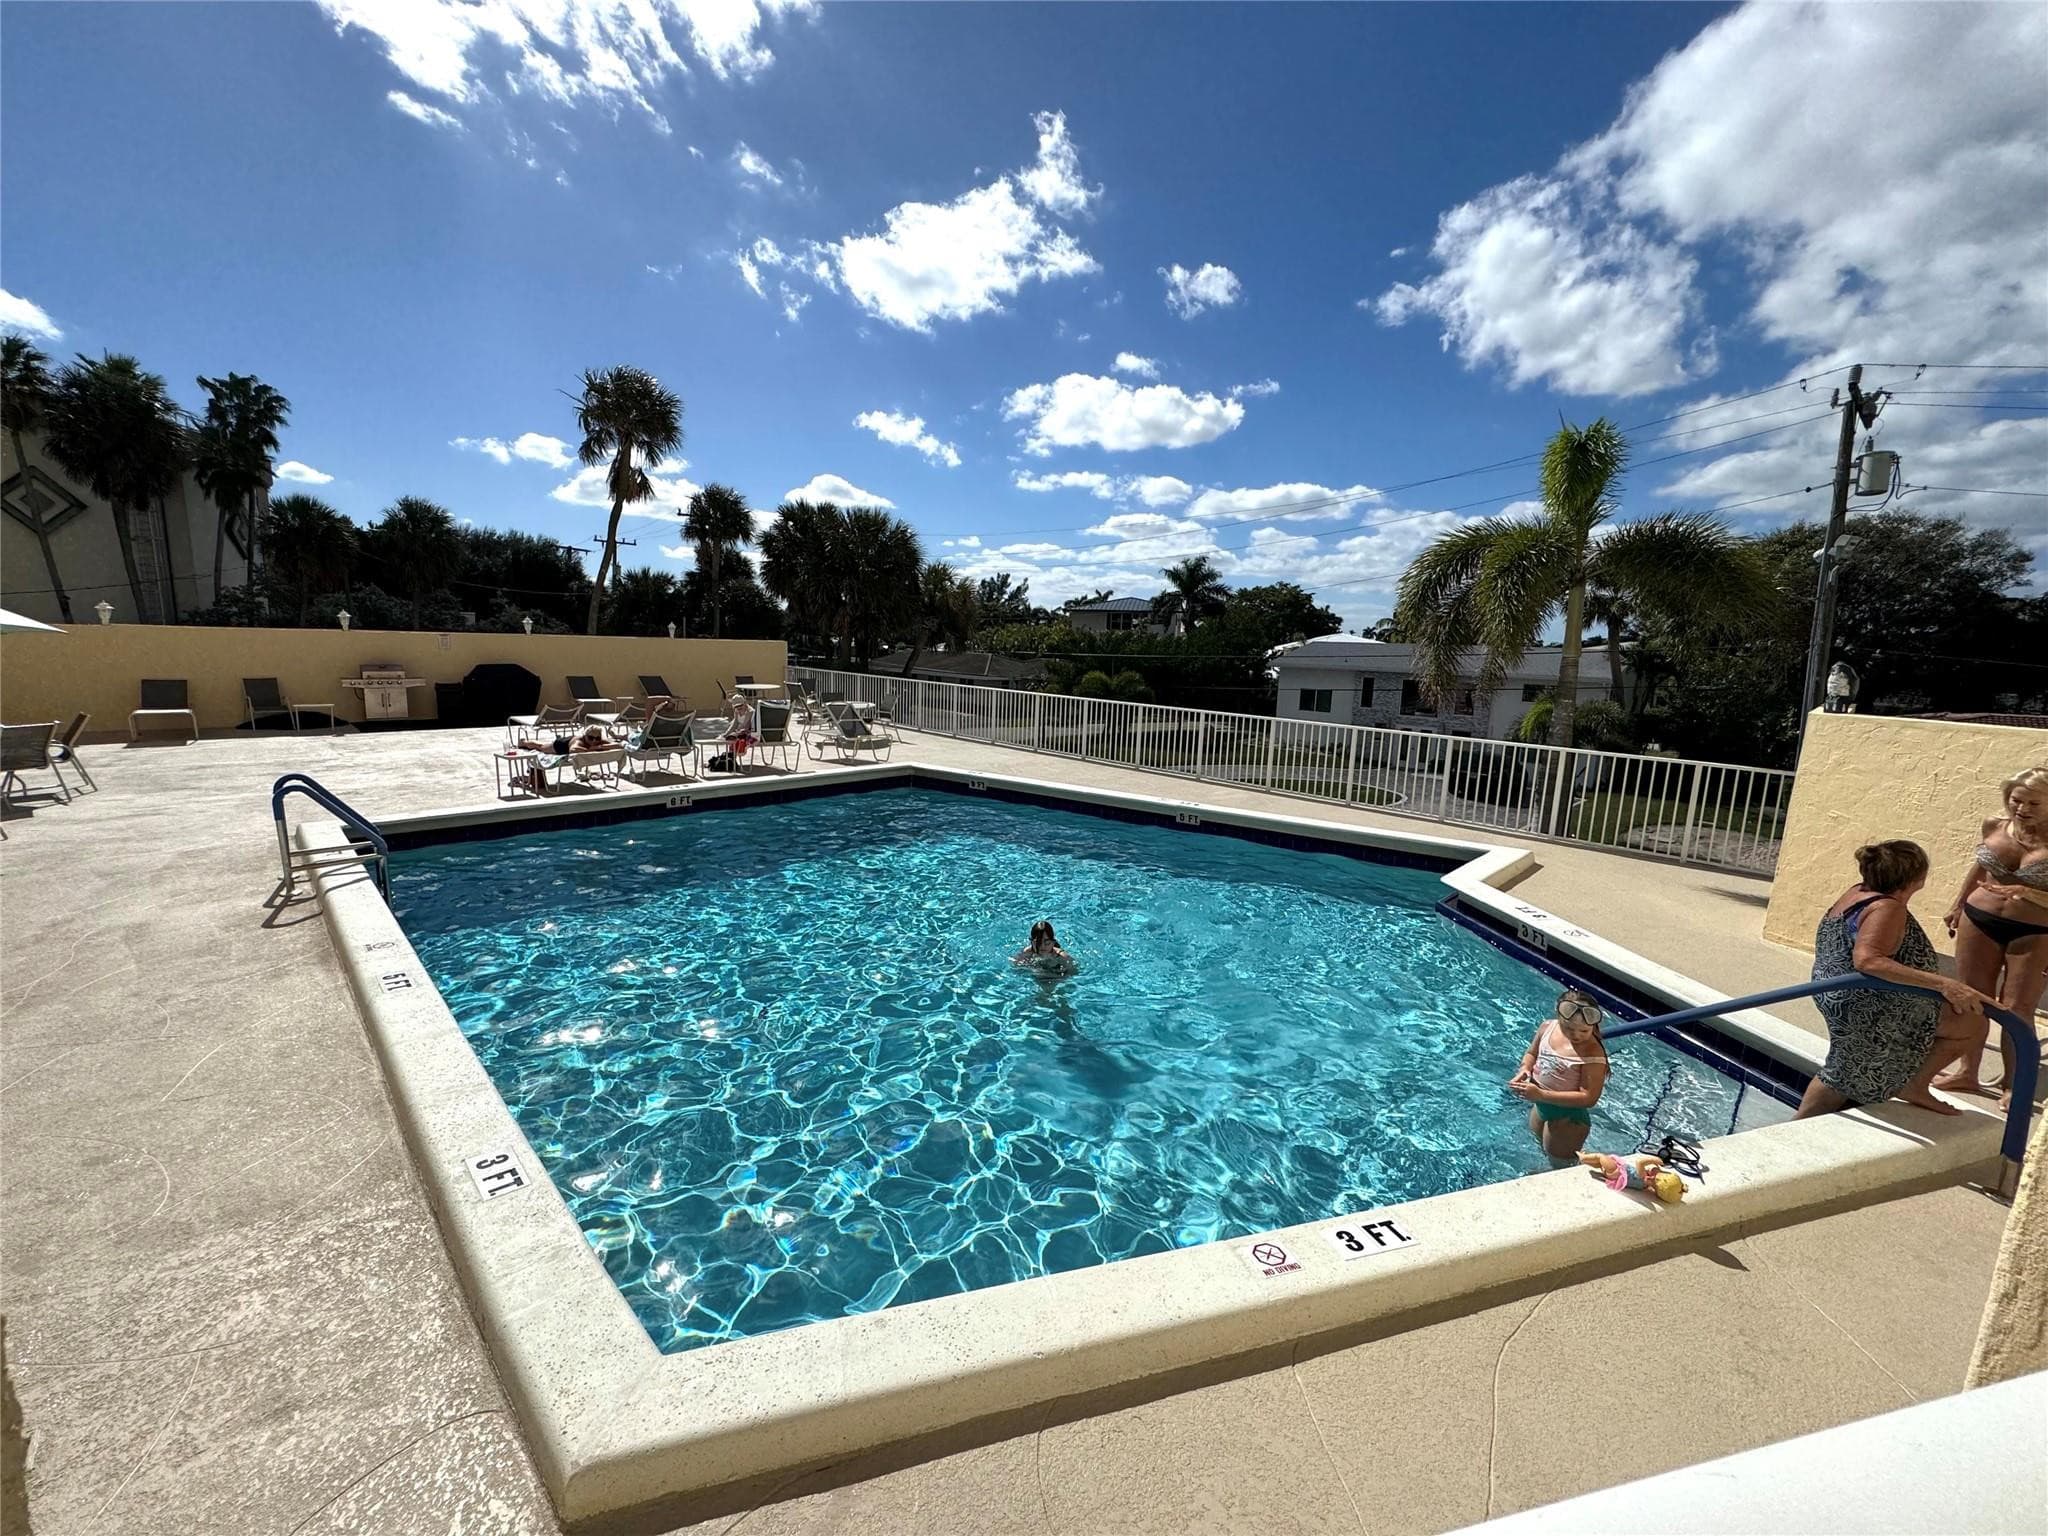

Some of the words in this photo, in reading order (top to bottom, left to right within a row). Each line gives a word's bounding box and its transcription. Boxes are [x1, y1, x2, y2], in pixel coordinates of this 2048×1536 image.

[476, 1154, 509, 1169] 3
[1335, 1230, 1364, 1252] 3
[1361, 1219, 1411, 1246] FT.
[1262, 1268, 1275, 1276] NO
[1275, 1262, 1302, 1274] DIVING
